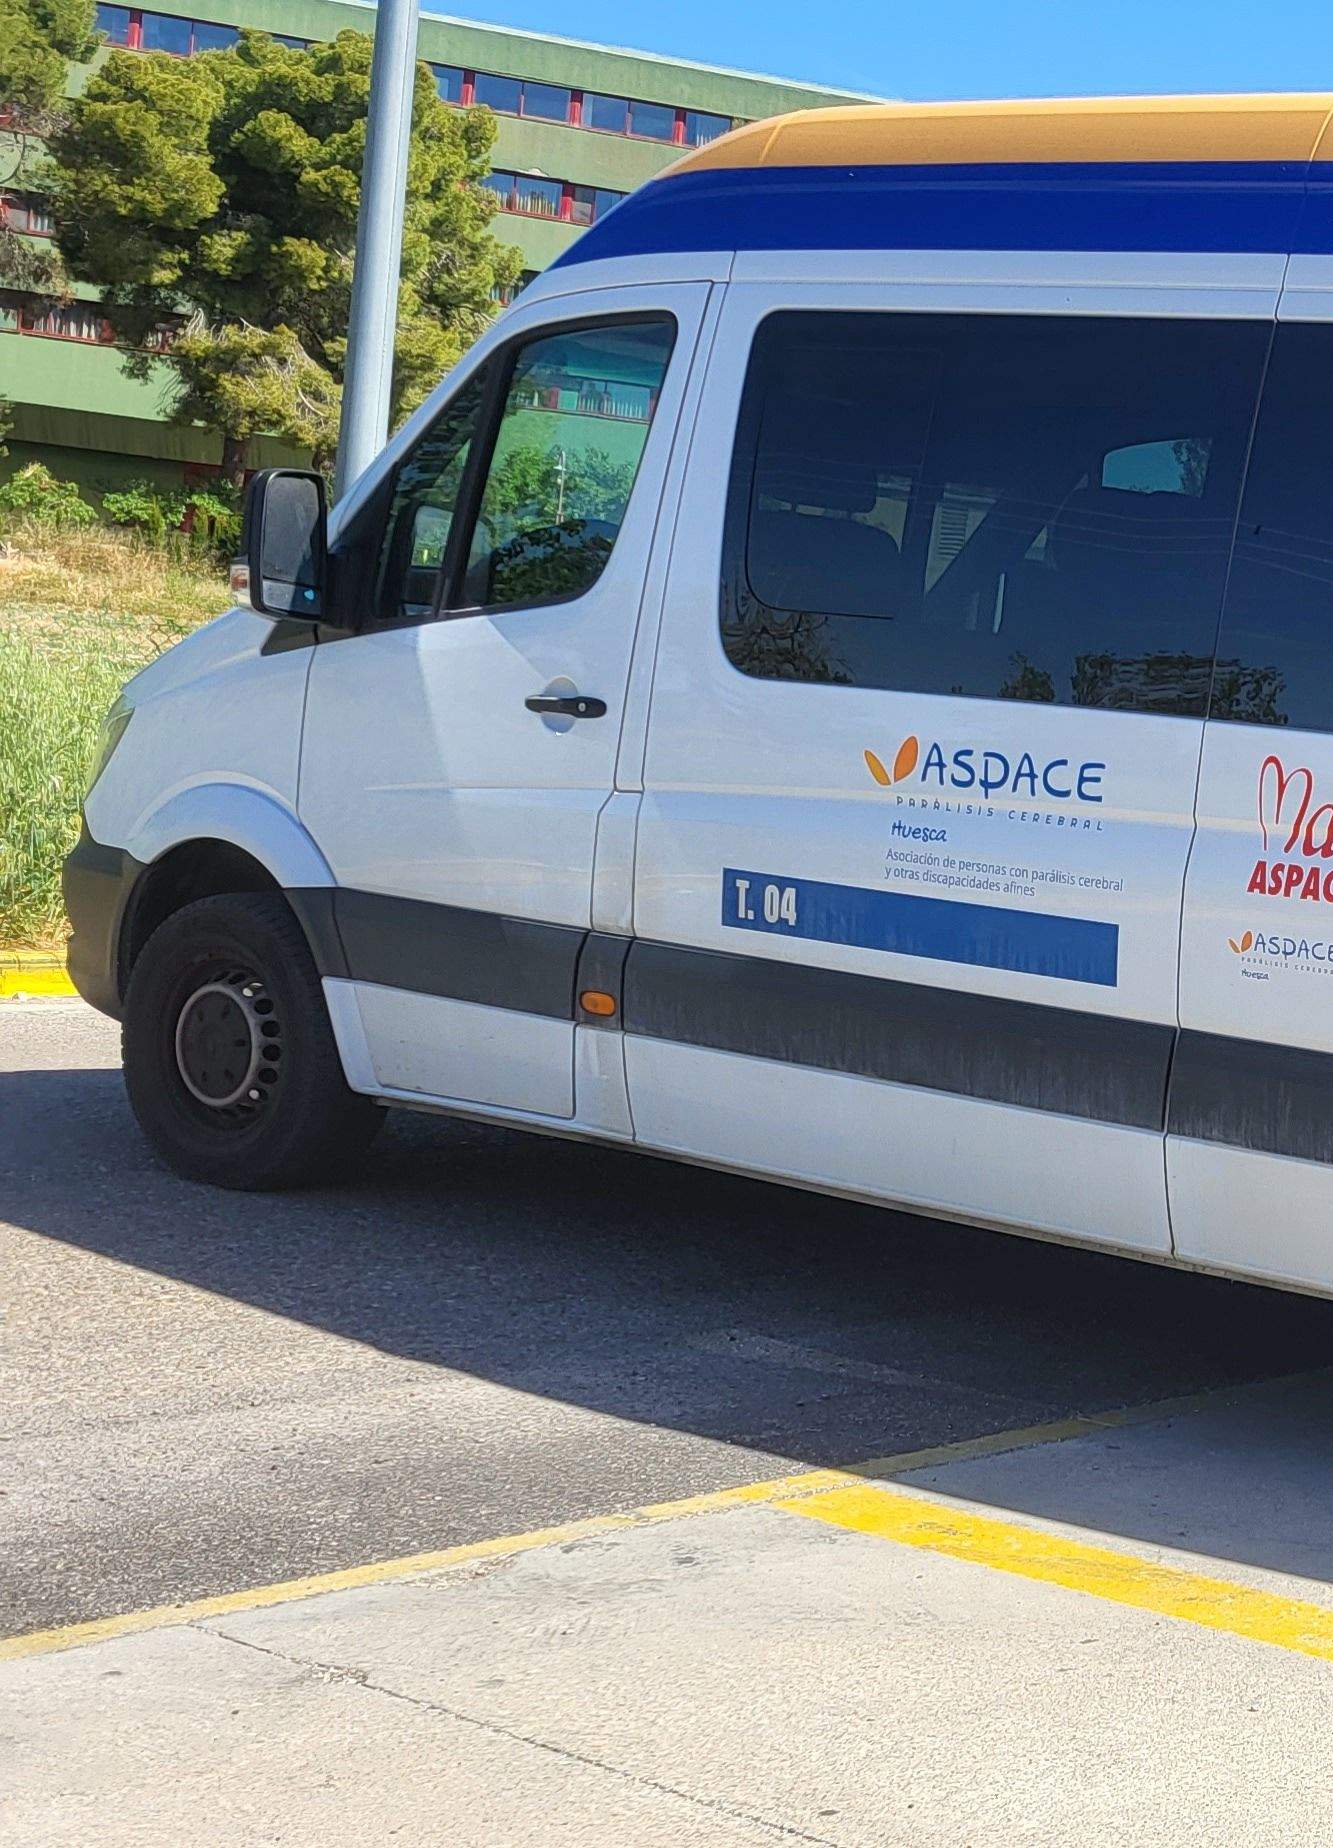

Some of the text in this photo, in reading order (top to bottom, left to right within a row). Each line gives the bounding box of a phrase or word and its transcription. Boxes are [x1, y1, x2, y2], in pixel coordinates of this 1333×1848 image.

[921, 742, 1106, 803] ASPACE
[891, 820, 948, 843] Huesca
[896, 796, 1104, 832] PARÁLISIS CEREBRAL
[884, 866, 1036, 897] y otras discapacidades afines
[886, 848, 1124, 892] Asociación de personas con parálisis cerebral
[735, 878, 797, 927] T. 04
[1241, 969, 1270, 981] Huesca
